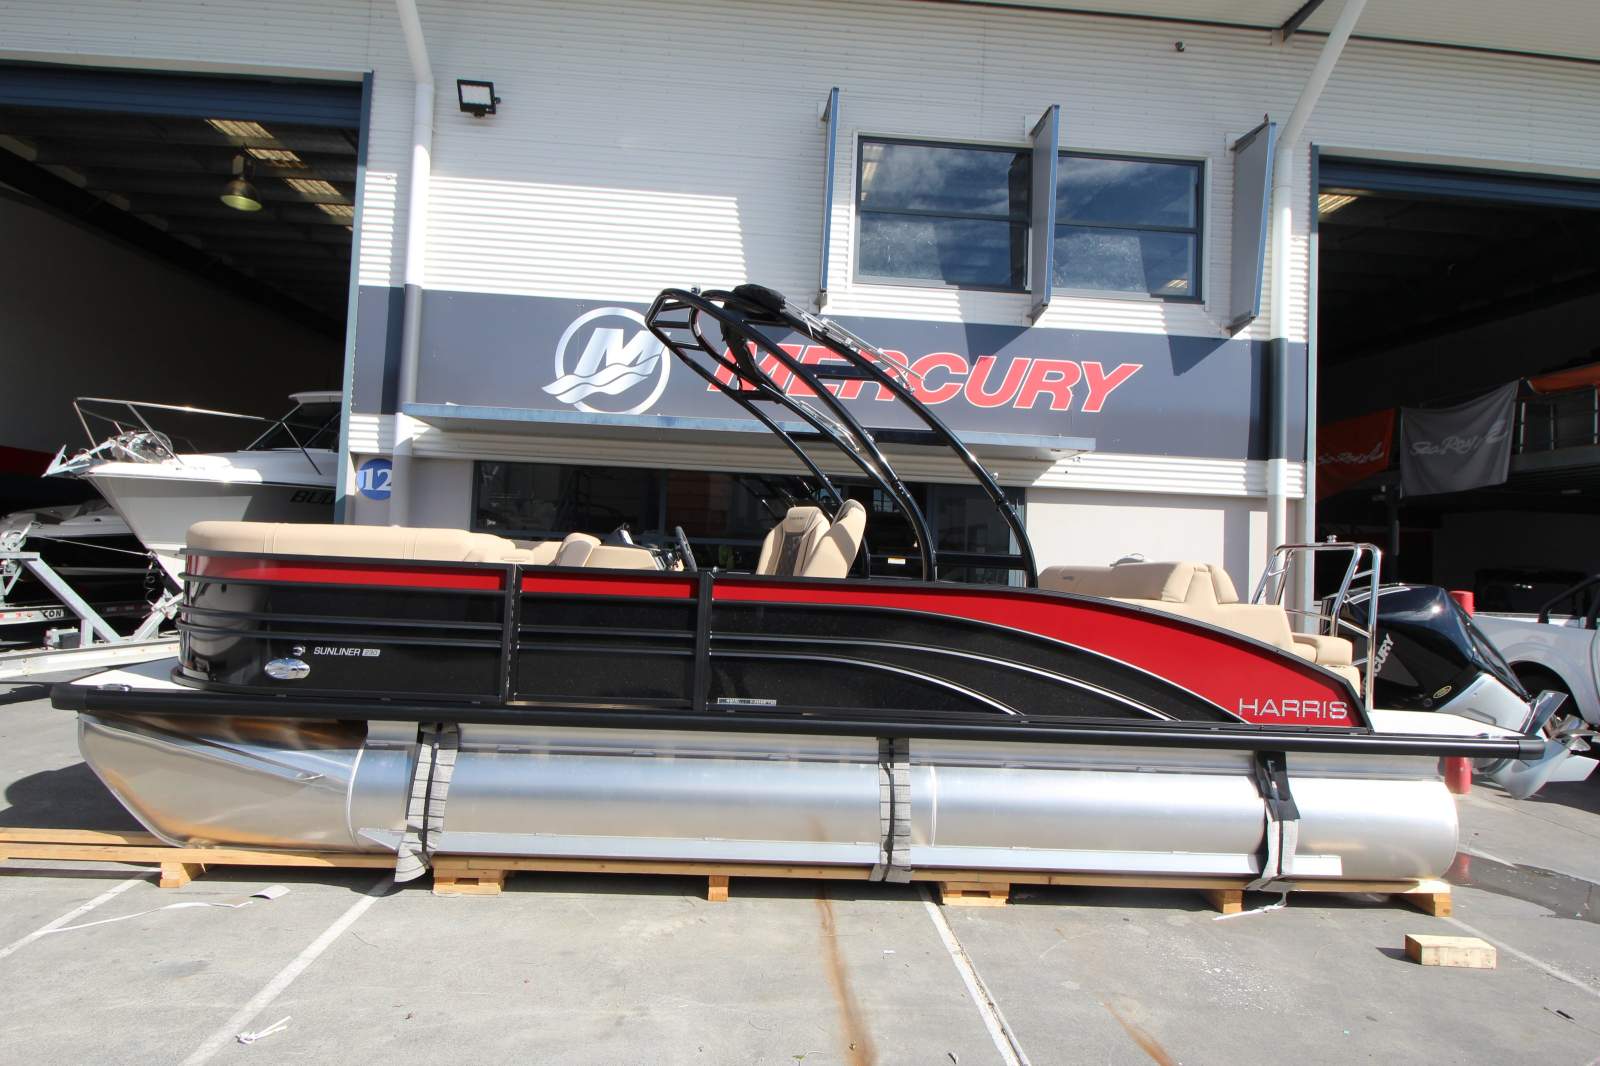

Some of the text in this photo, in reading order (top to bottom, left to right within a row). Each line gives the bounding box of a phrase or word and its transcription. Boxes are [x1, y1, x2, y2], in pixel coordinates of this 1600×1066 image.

[362, 467, 392, 491] 12
[313, 646, 361, 656] SUNLINER
[1238, 697, 1348, 719] HARRIS
